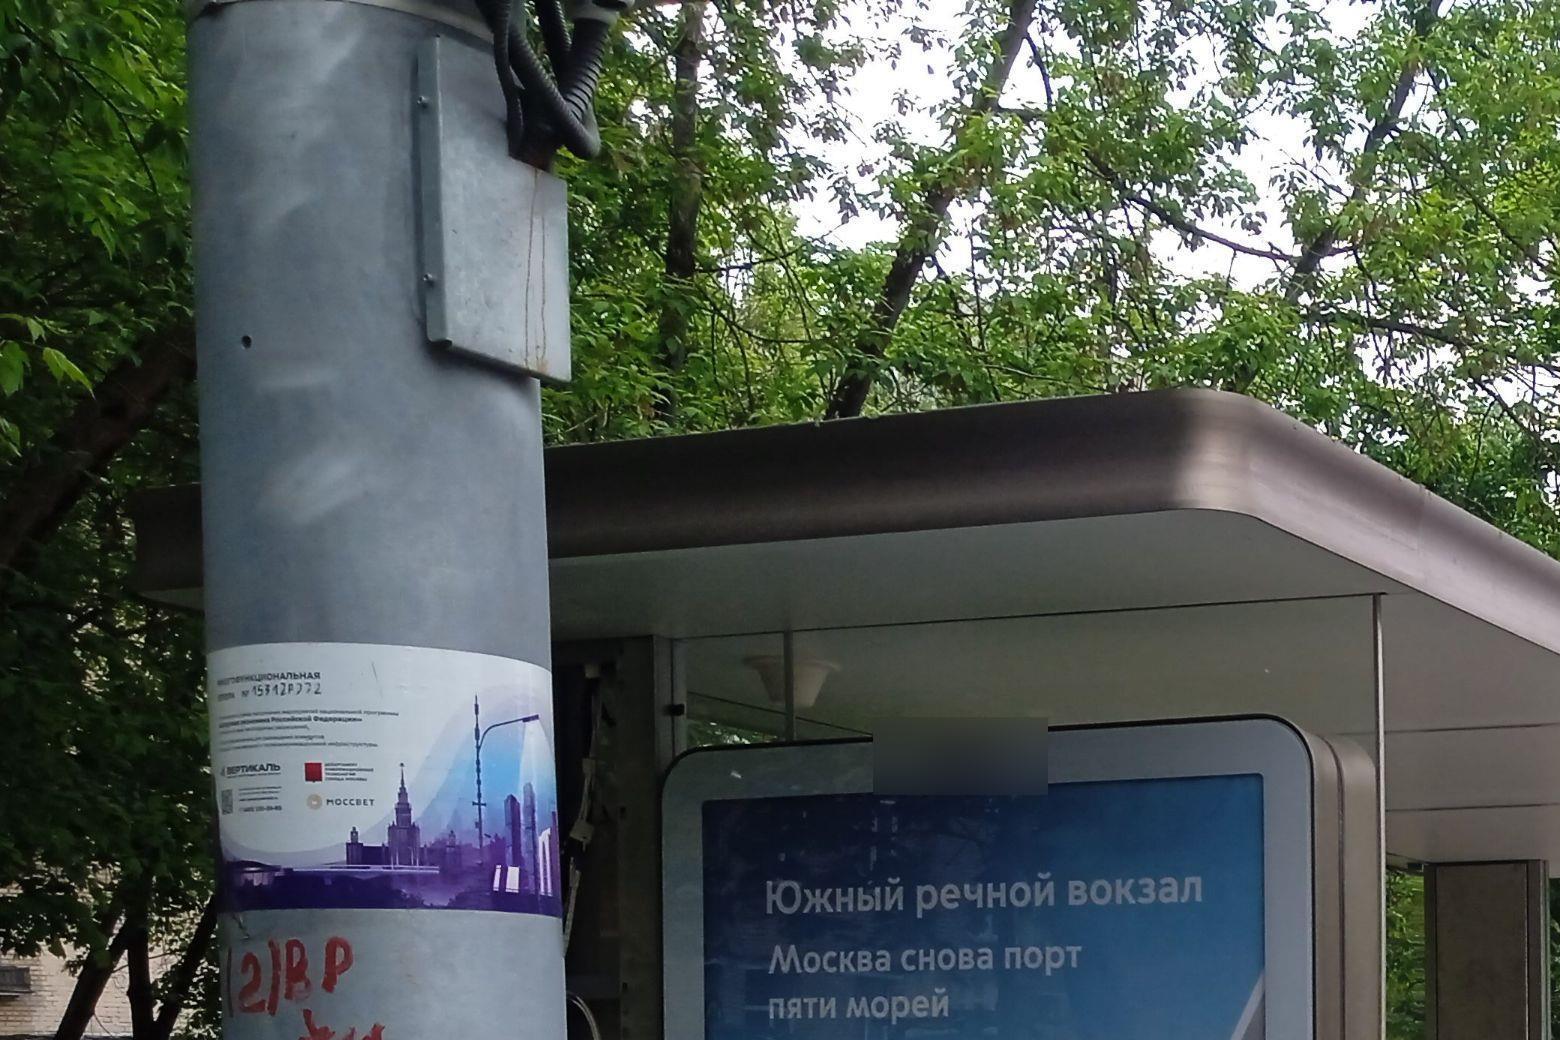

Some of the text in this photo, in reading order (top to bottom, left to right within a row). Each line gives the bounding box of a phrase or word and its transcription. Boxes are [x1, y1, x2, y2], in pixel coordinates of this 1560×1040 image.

[326, 798, 375, 806] МОССВЕТ
[765, 872, 1203, 918] Южный речной вокзал
[768, 943, 1083, 976] Москва снова порт
[768, 987, 950, 1025] пяти морей
